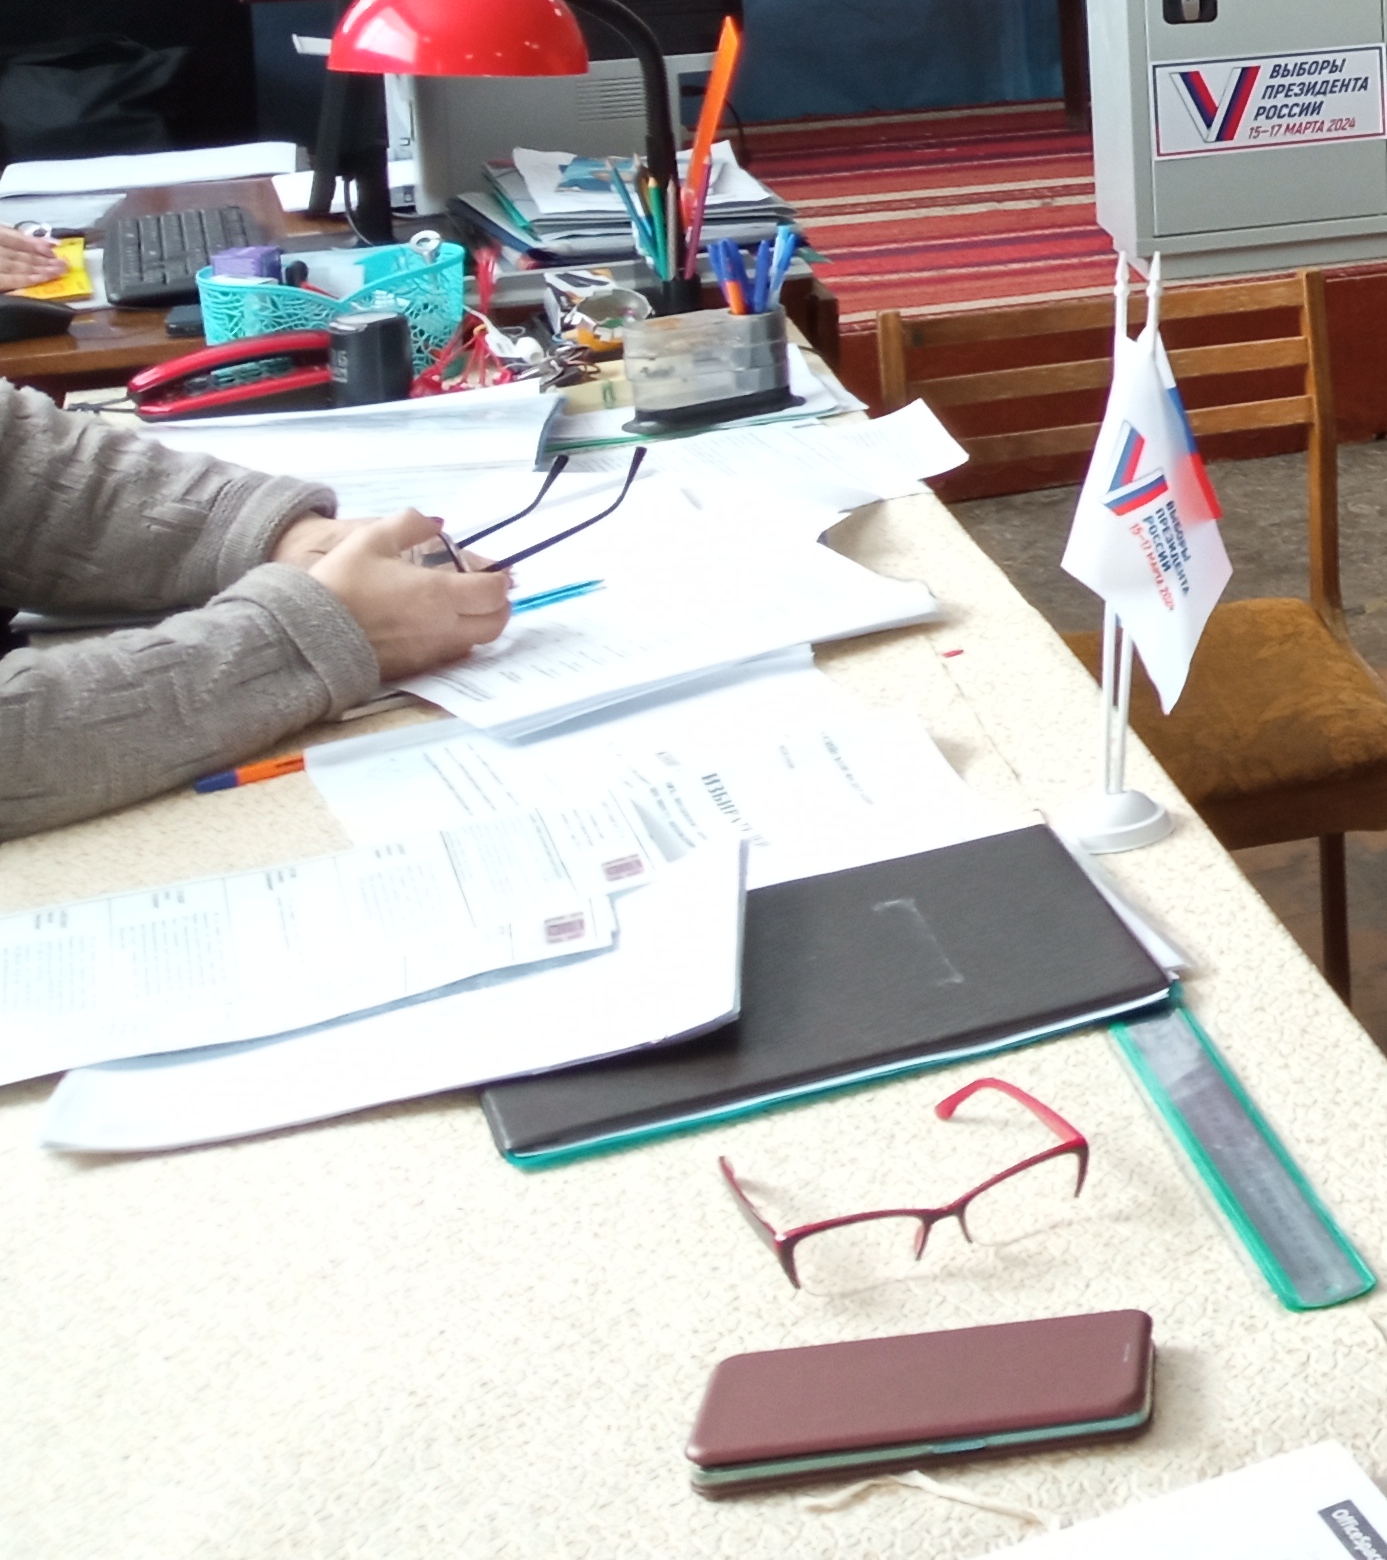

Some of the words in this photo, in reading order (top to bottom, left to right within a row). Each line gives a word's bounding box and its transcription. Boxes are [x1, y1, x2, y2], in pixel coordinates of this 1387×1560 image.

[1269, 58, 1346, 79] ВЫБОРЫ
[1261, 77, 1369, 100] ПРЕЗИДЕНТА
[1254, 101, 1324, 121] РОССИИ
[1284, 121, 1325, 136] МАРТА
[1327, 117, 1356, 132] 2024
[1142, 515, 1172, 572] РОССИИ
[1166, 500, 1191, 561] ВЫБОРЫ
[1155, 507, 1189, 595] ПРЕЗИДЕНТА
[1331, 1509, 1387, 1560] OfficeSpac
